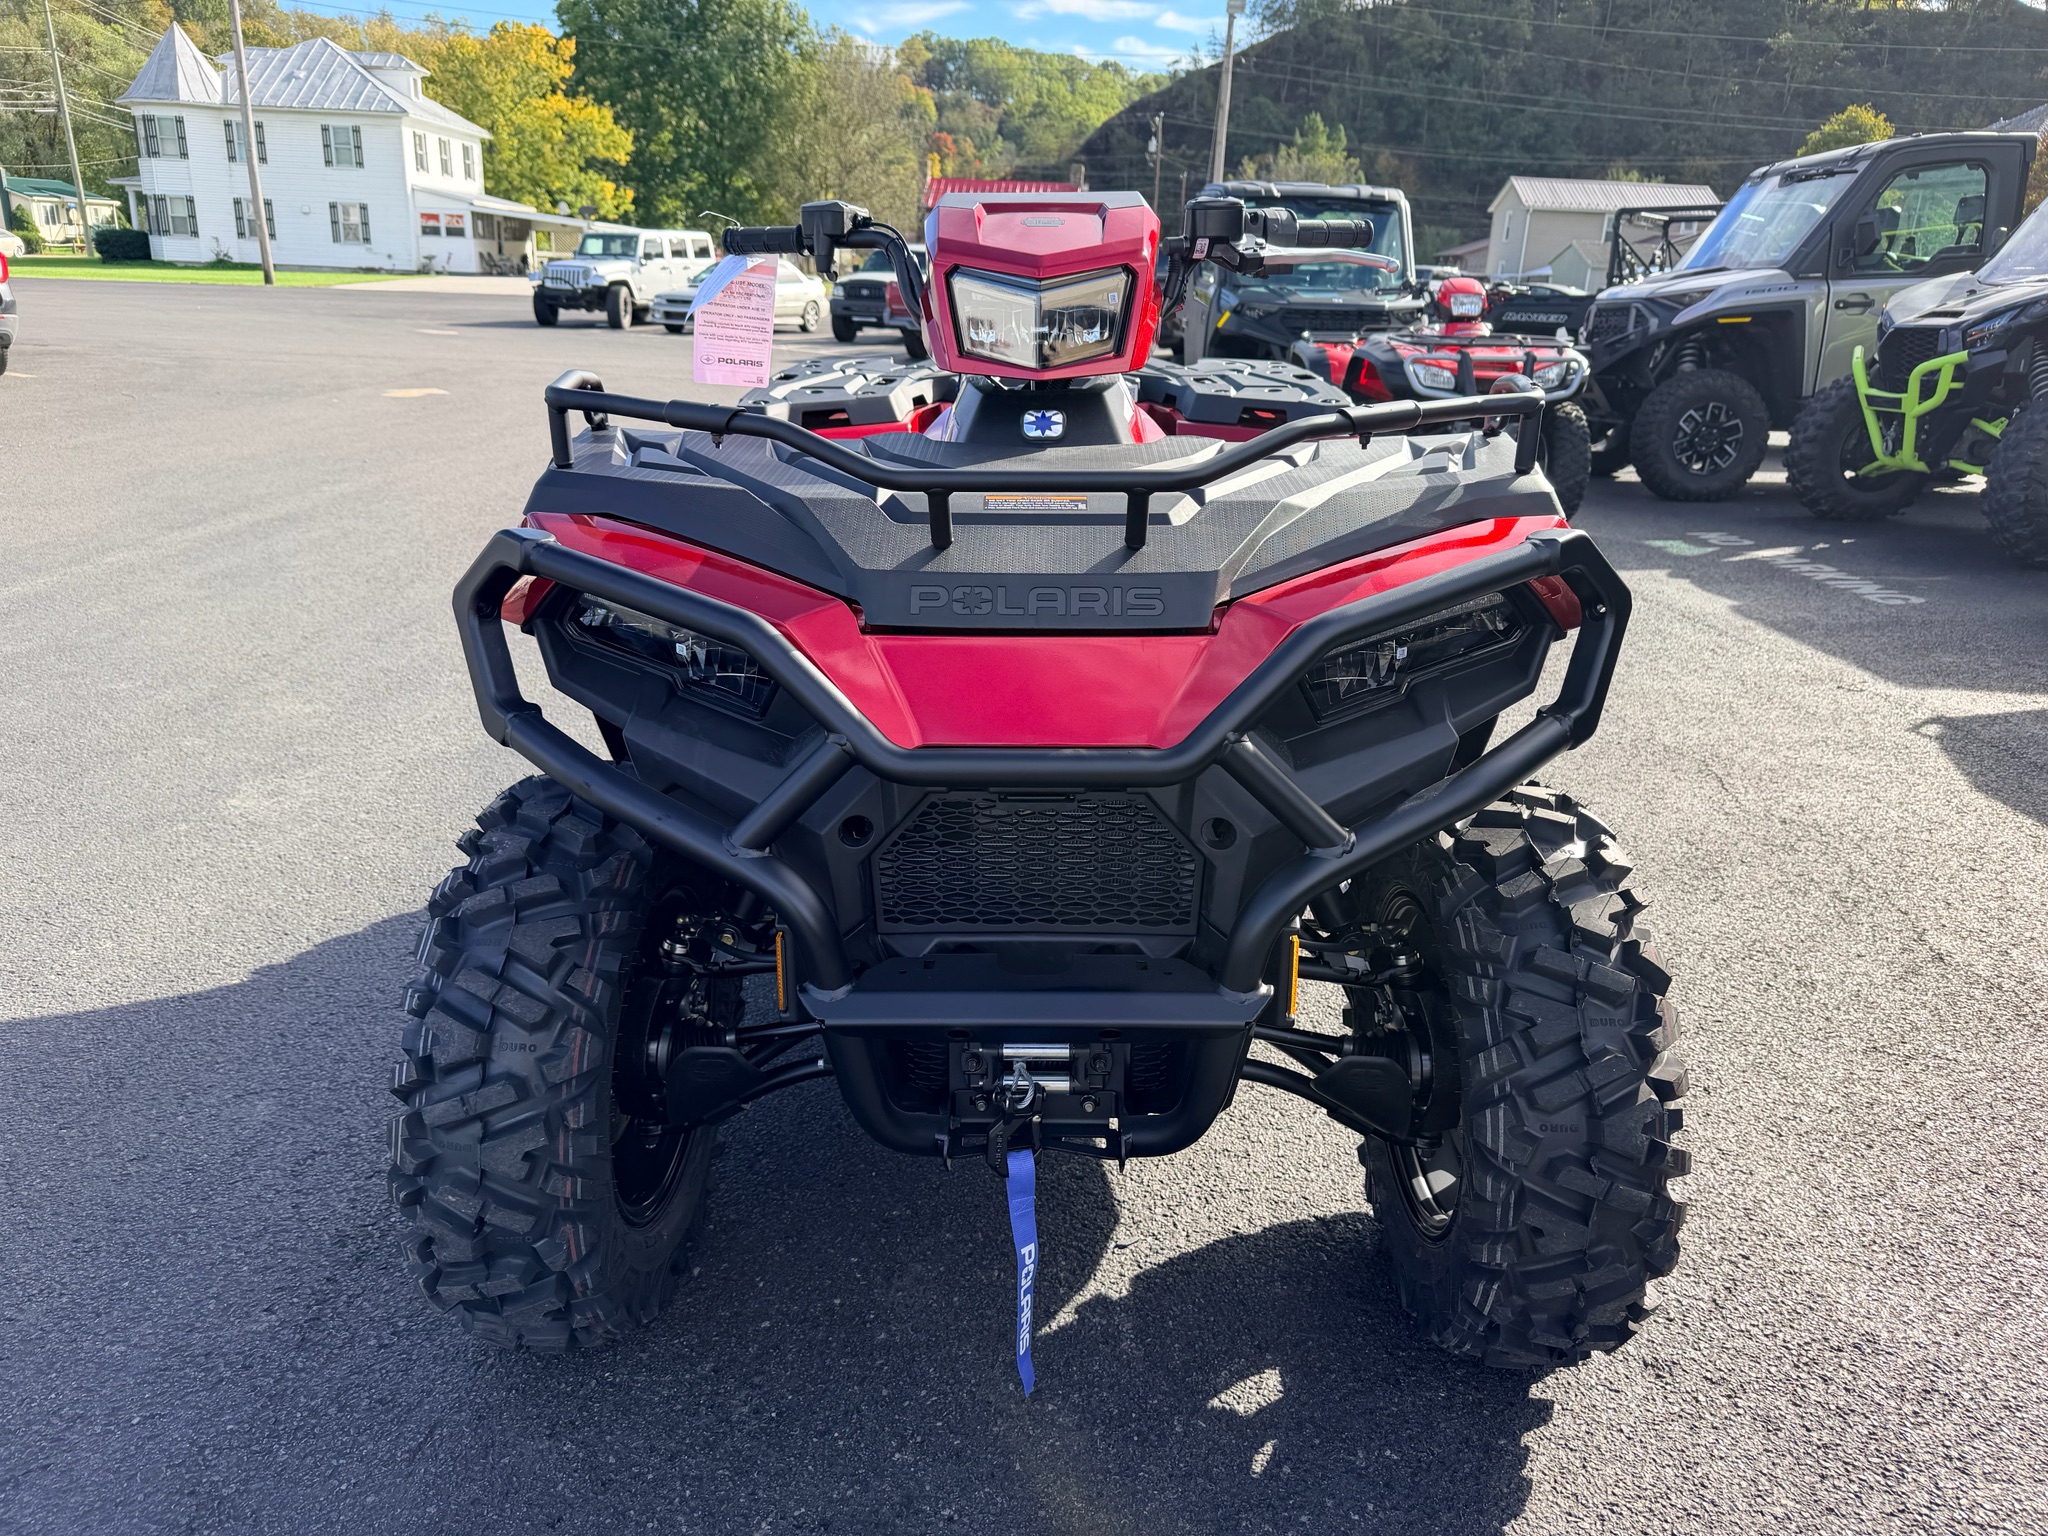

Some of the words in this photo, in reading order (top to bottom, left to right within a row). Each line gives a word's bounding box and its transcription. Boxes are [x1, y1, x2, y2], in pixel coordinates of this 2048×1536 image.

[1746, 285, 1798, 295] 1500
[718, 357, 763, 368] POLARIS
[910, 585, 1166, 616] POLARIS
[1589, 1017, 1625, 1028] DURO
[499, 1041, 538, 1053] DURO
[1538, 1123, 1579, 1133] DURO
[1019, 1242, 1036, 1356] POLARIS
